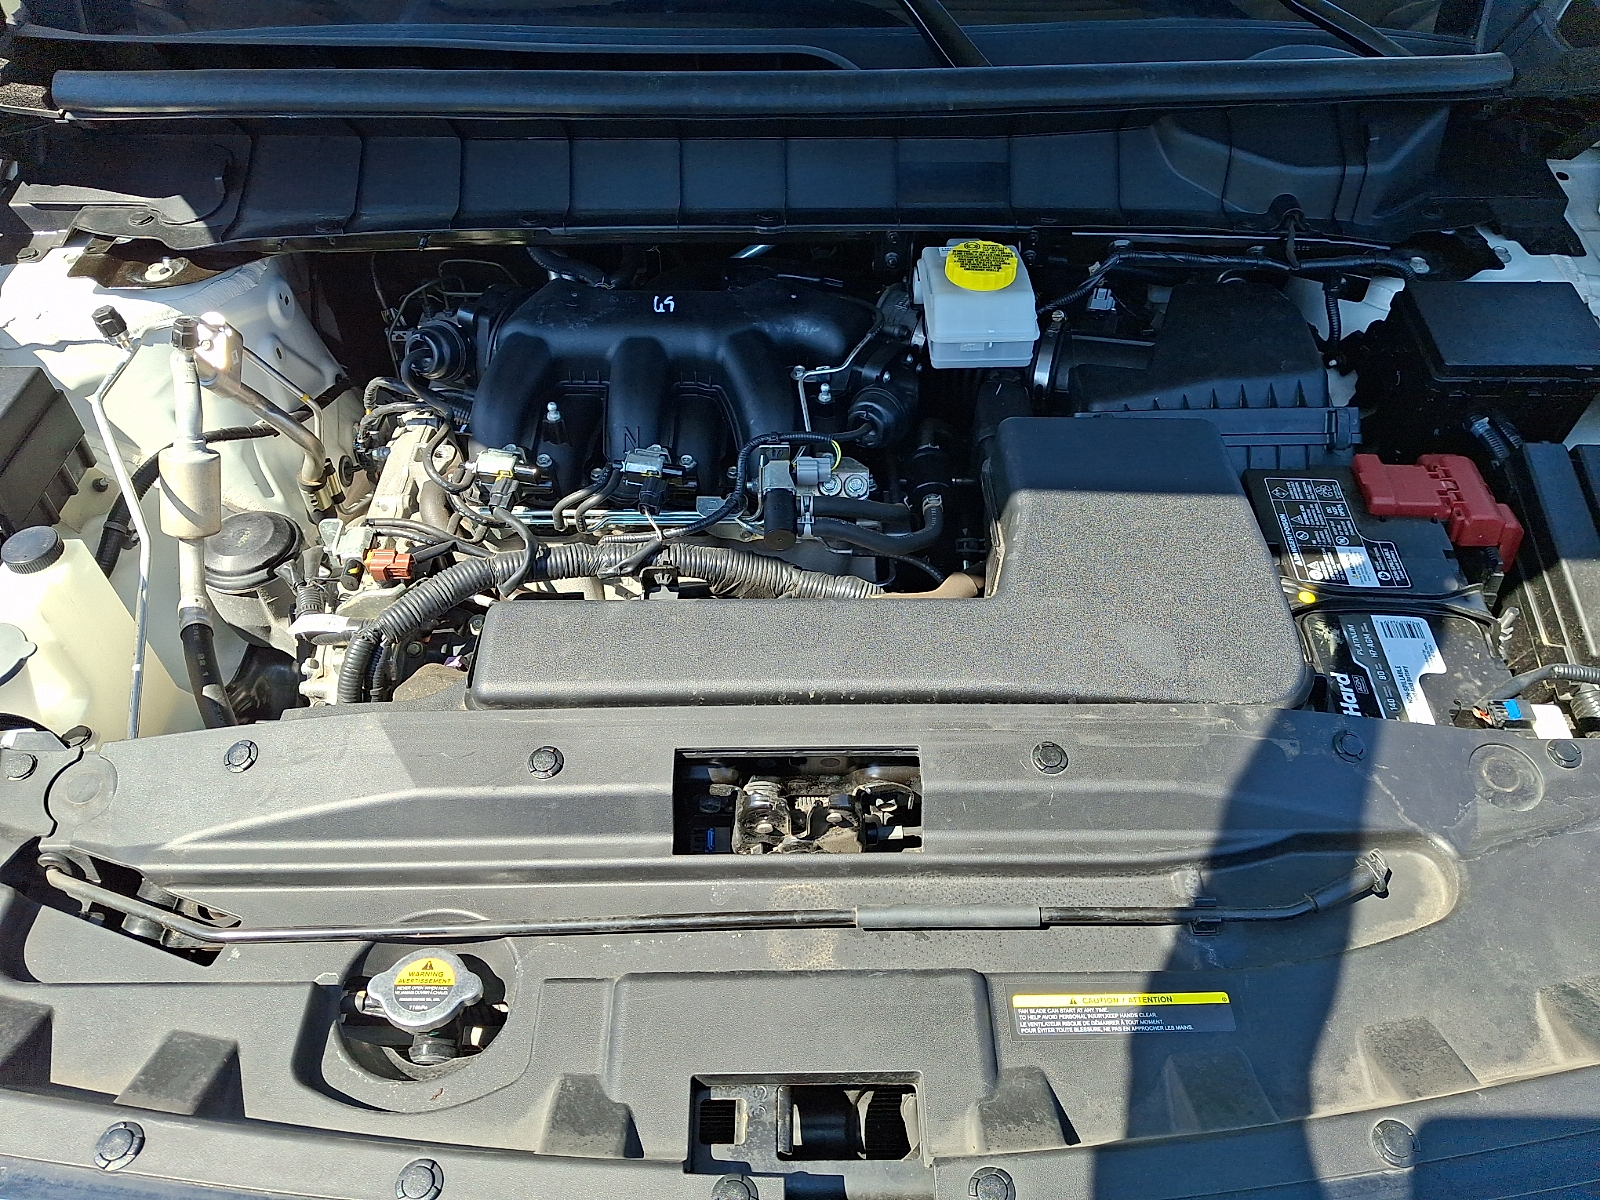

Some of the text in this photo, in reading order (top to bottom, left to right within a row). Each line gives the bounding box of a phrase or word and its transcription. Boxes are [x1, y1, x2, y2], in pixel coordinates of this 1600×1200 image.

[1382, 547, 1400, 580] NON-SPILLABLE
[1346, 624, 1365, 656] PLATINUM
[1378, 670, 1387, 681] 80
[1394, 665, 1413, 703] NON-SPILLABLE
[1329, 671, 1362, 717] Hard
[1386, 698, 1399, 711] 140
[1082, 996, 1120, 1004] CAUTION
[1128, 995, 1173, 1003] ATTENTION
